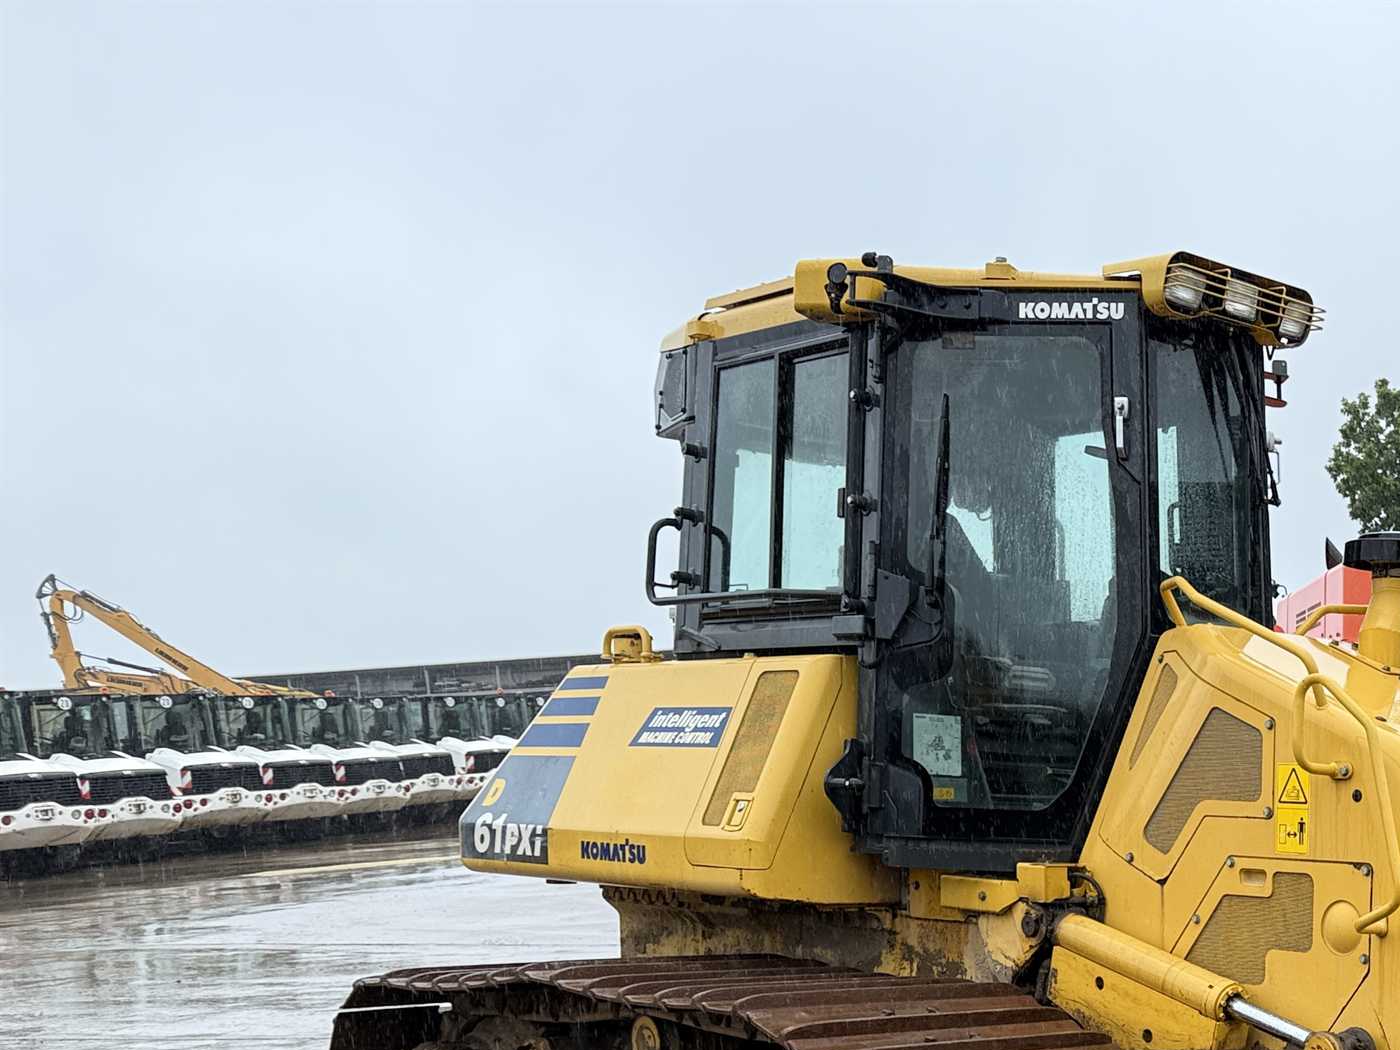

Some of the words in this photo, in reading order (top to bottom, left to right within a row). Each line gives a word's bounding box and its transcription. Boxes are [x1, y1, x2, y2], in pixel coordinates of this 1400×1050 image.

[1018, 297, 1125, 320] KOMATSU
[648, 710, 728, 732] intelligent
[484, 778, 507, 806] D
[580, 838, 647, 865] KOMATSU
